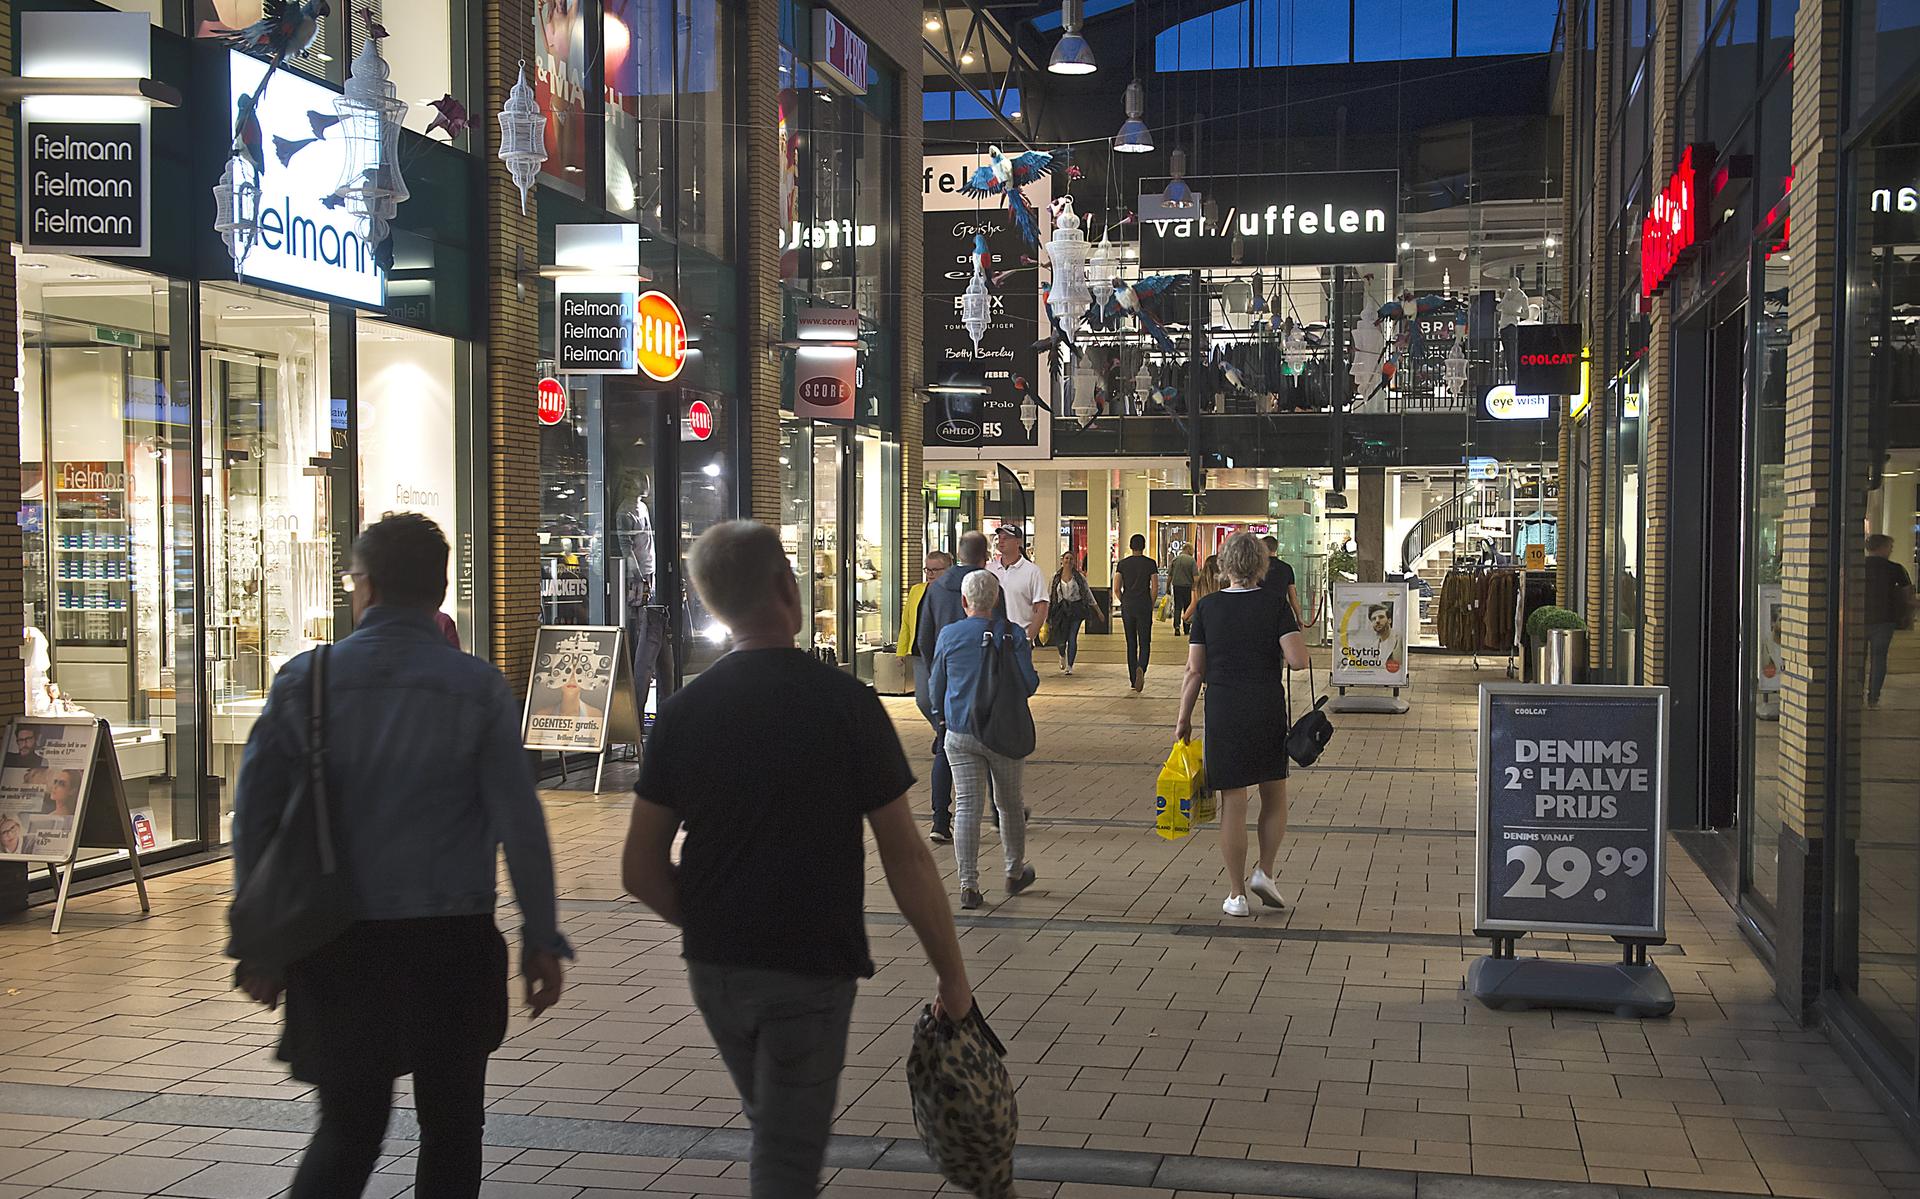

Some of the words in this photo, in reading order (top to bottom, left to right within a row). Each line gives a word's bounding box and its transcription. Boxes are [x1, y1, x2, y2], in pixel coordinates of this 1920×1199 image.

[34, 133, 132, 160] fielmann
[34, 170, 132, 197] fielmann
[34, 207, 132, 234] fielmann
[952, 221, 1006, 239] Geisha
[563, 299, 629, 316] fielmann
[799, 317, 858, 327] www.score.nl
[563, 322, 629, 339] fielmann
[563, 345, 629, 361] fielmann
[944, 347, 972, 362] Betty
[976, 346, 1014, 361] Barclay
[1520, 353, 1573, 365] COOLCAT
[804, 383, 845, 398] SCORE
[1493, 399, 1513, 409] eye
[1517, 396, 1545, 405] wish
[942, 427, 976, 435] AMIGO
[541, 578, 588, 597] JACKETS
[1341, 647, 1380, 658] Citytrip
[1341, 657, 1382, 667] Cadeau
[575, 720, 599, 731] gratis.
[1515, 739, 1639, 764] DENIMS
[1541, 767, 1648, 791] HALVE
[1535, 794, 1618, 819] PRIJS
[1503, 832, 1539, 840] DENIMS
[1541, 834, 1575, 842] VANAF
